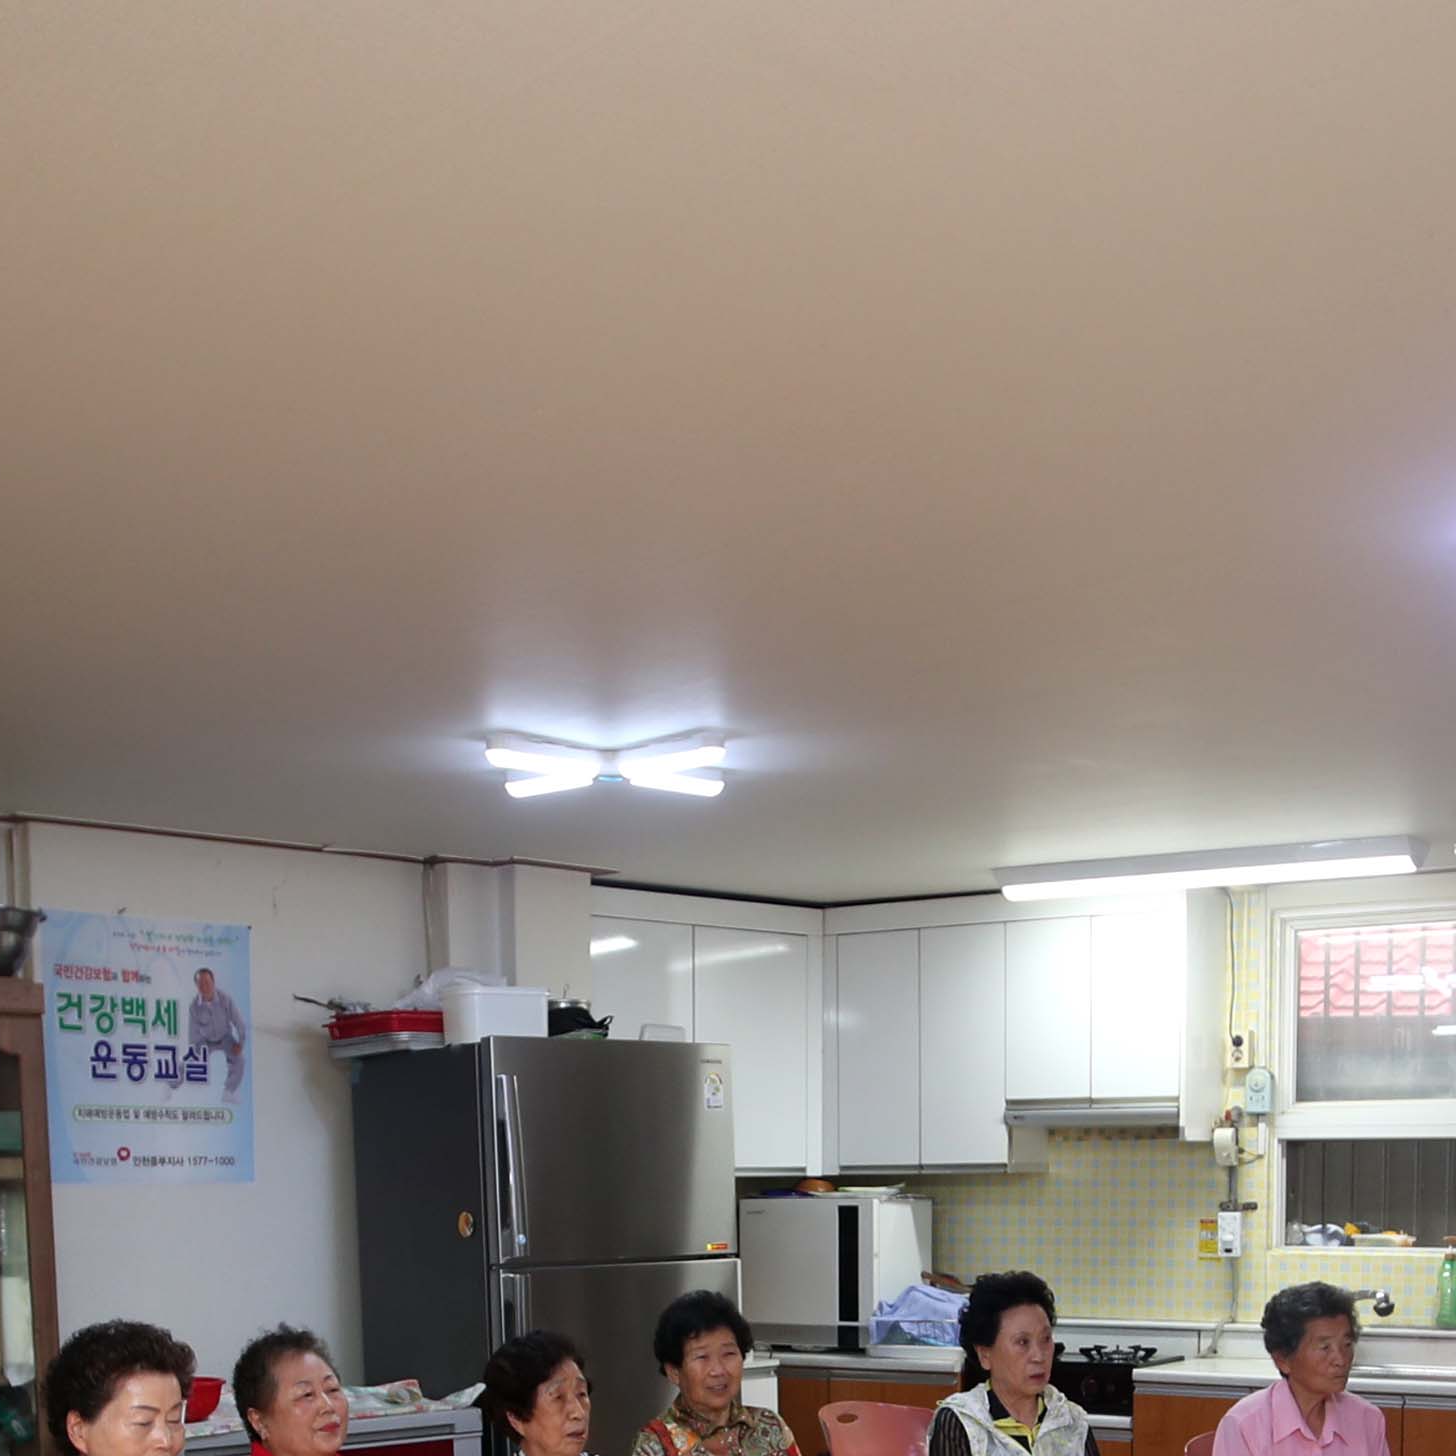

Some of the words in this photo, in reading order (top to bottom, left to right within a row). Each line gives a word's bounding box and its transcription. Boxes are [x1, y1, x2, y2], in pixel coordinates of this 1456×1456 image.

[56, 991, 179, 1036] 건강백세
[90, 1039, 210, 1083] 운동교실
[188, 1155, 236, 1167] 1577-1000
